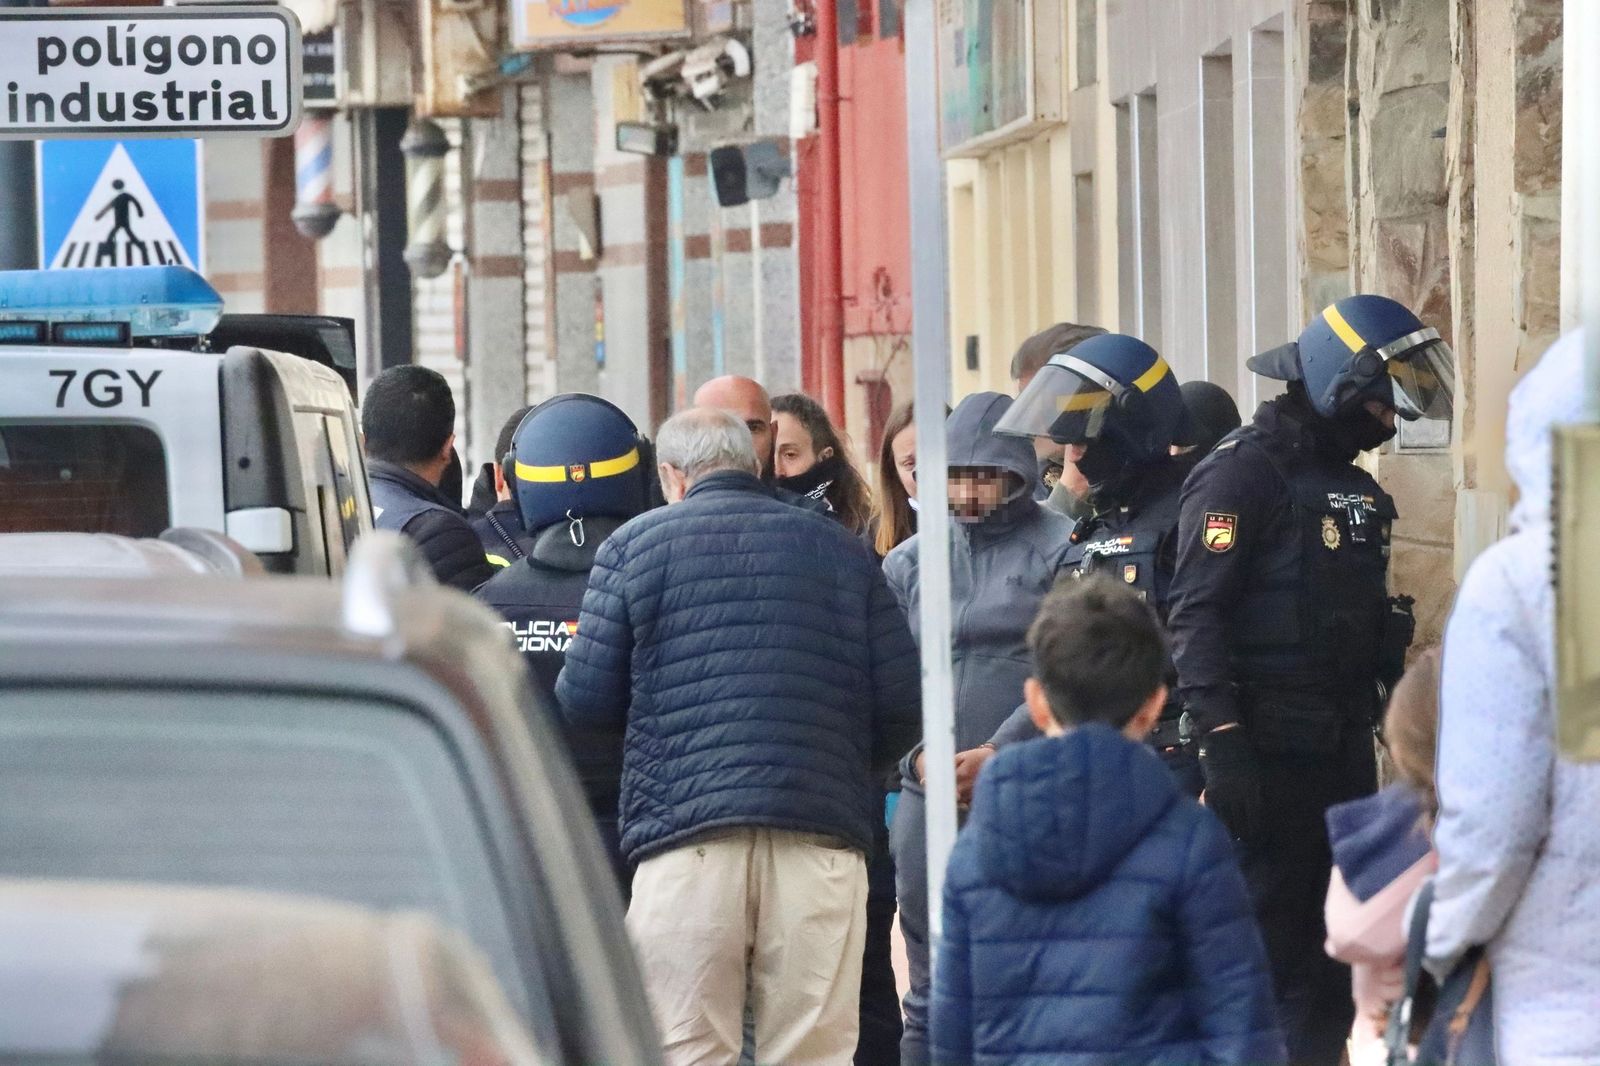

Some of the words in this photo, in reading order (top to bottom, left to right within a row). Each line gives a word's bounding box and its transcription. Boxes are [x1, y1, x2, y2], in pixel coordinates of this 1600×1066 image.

[37, 23, 277, 75] polígono
[7, 79, 278, 123] industrial
[48, 368, 163, 409] 7GY
